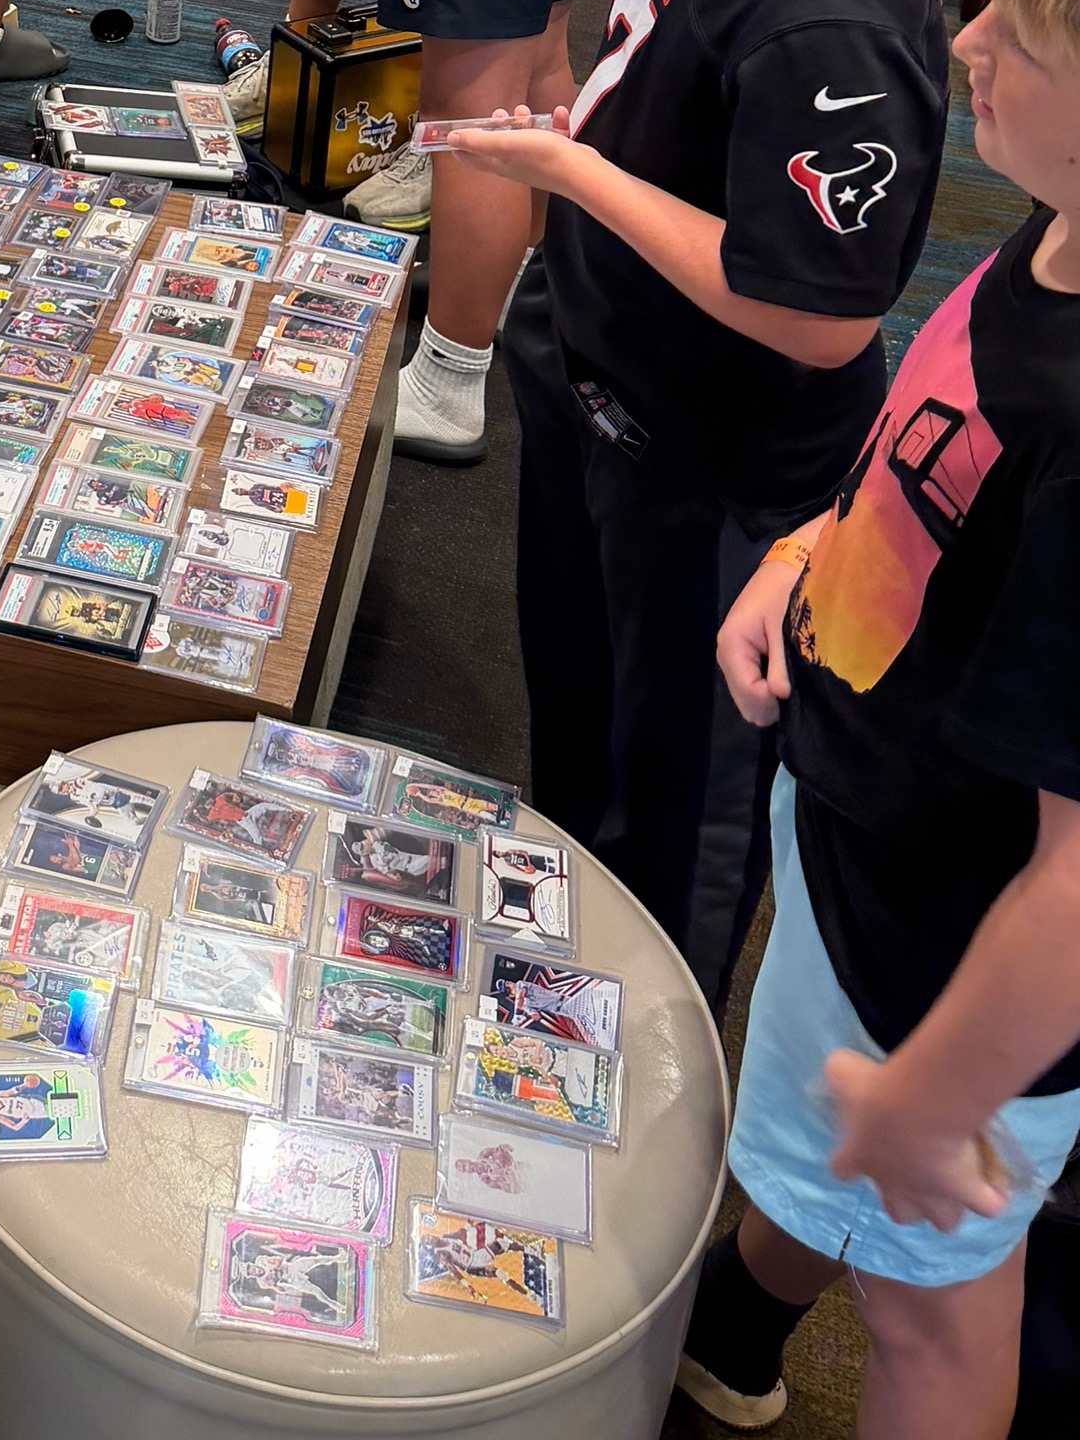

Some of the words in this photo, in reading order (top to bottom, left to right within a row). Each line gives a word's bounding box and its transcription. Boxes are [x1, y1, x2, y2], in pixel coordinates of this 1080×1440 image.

[20, 895, 36, 930] STAR
[164, 932, 187, 999] PIRATES
[1, 998, 19, 1032] DRAFT
